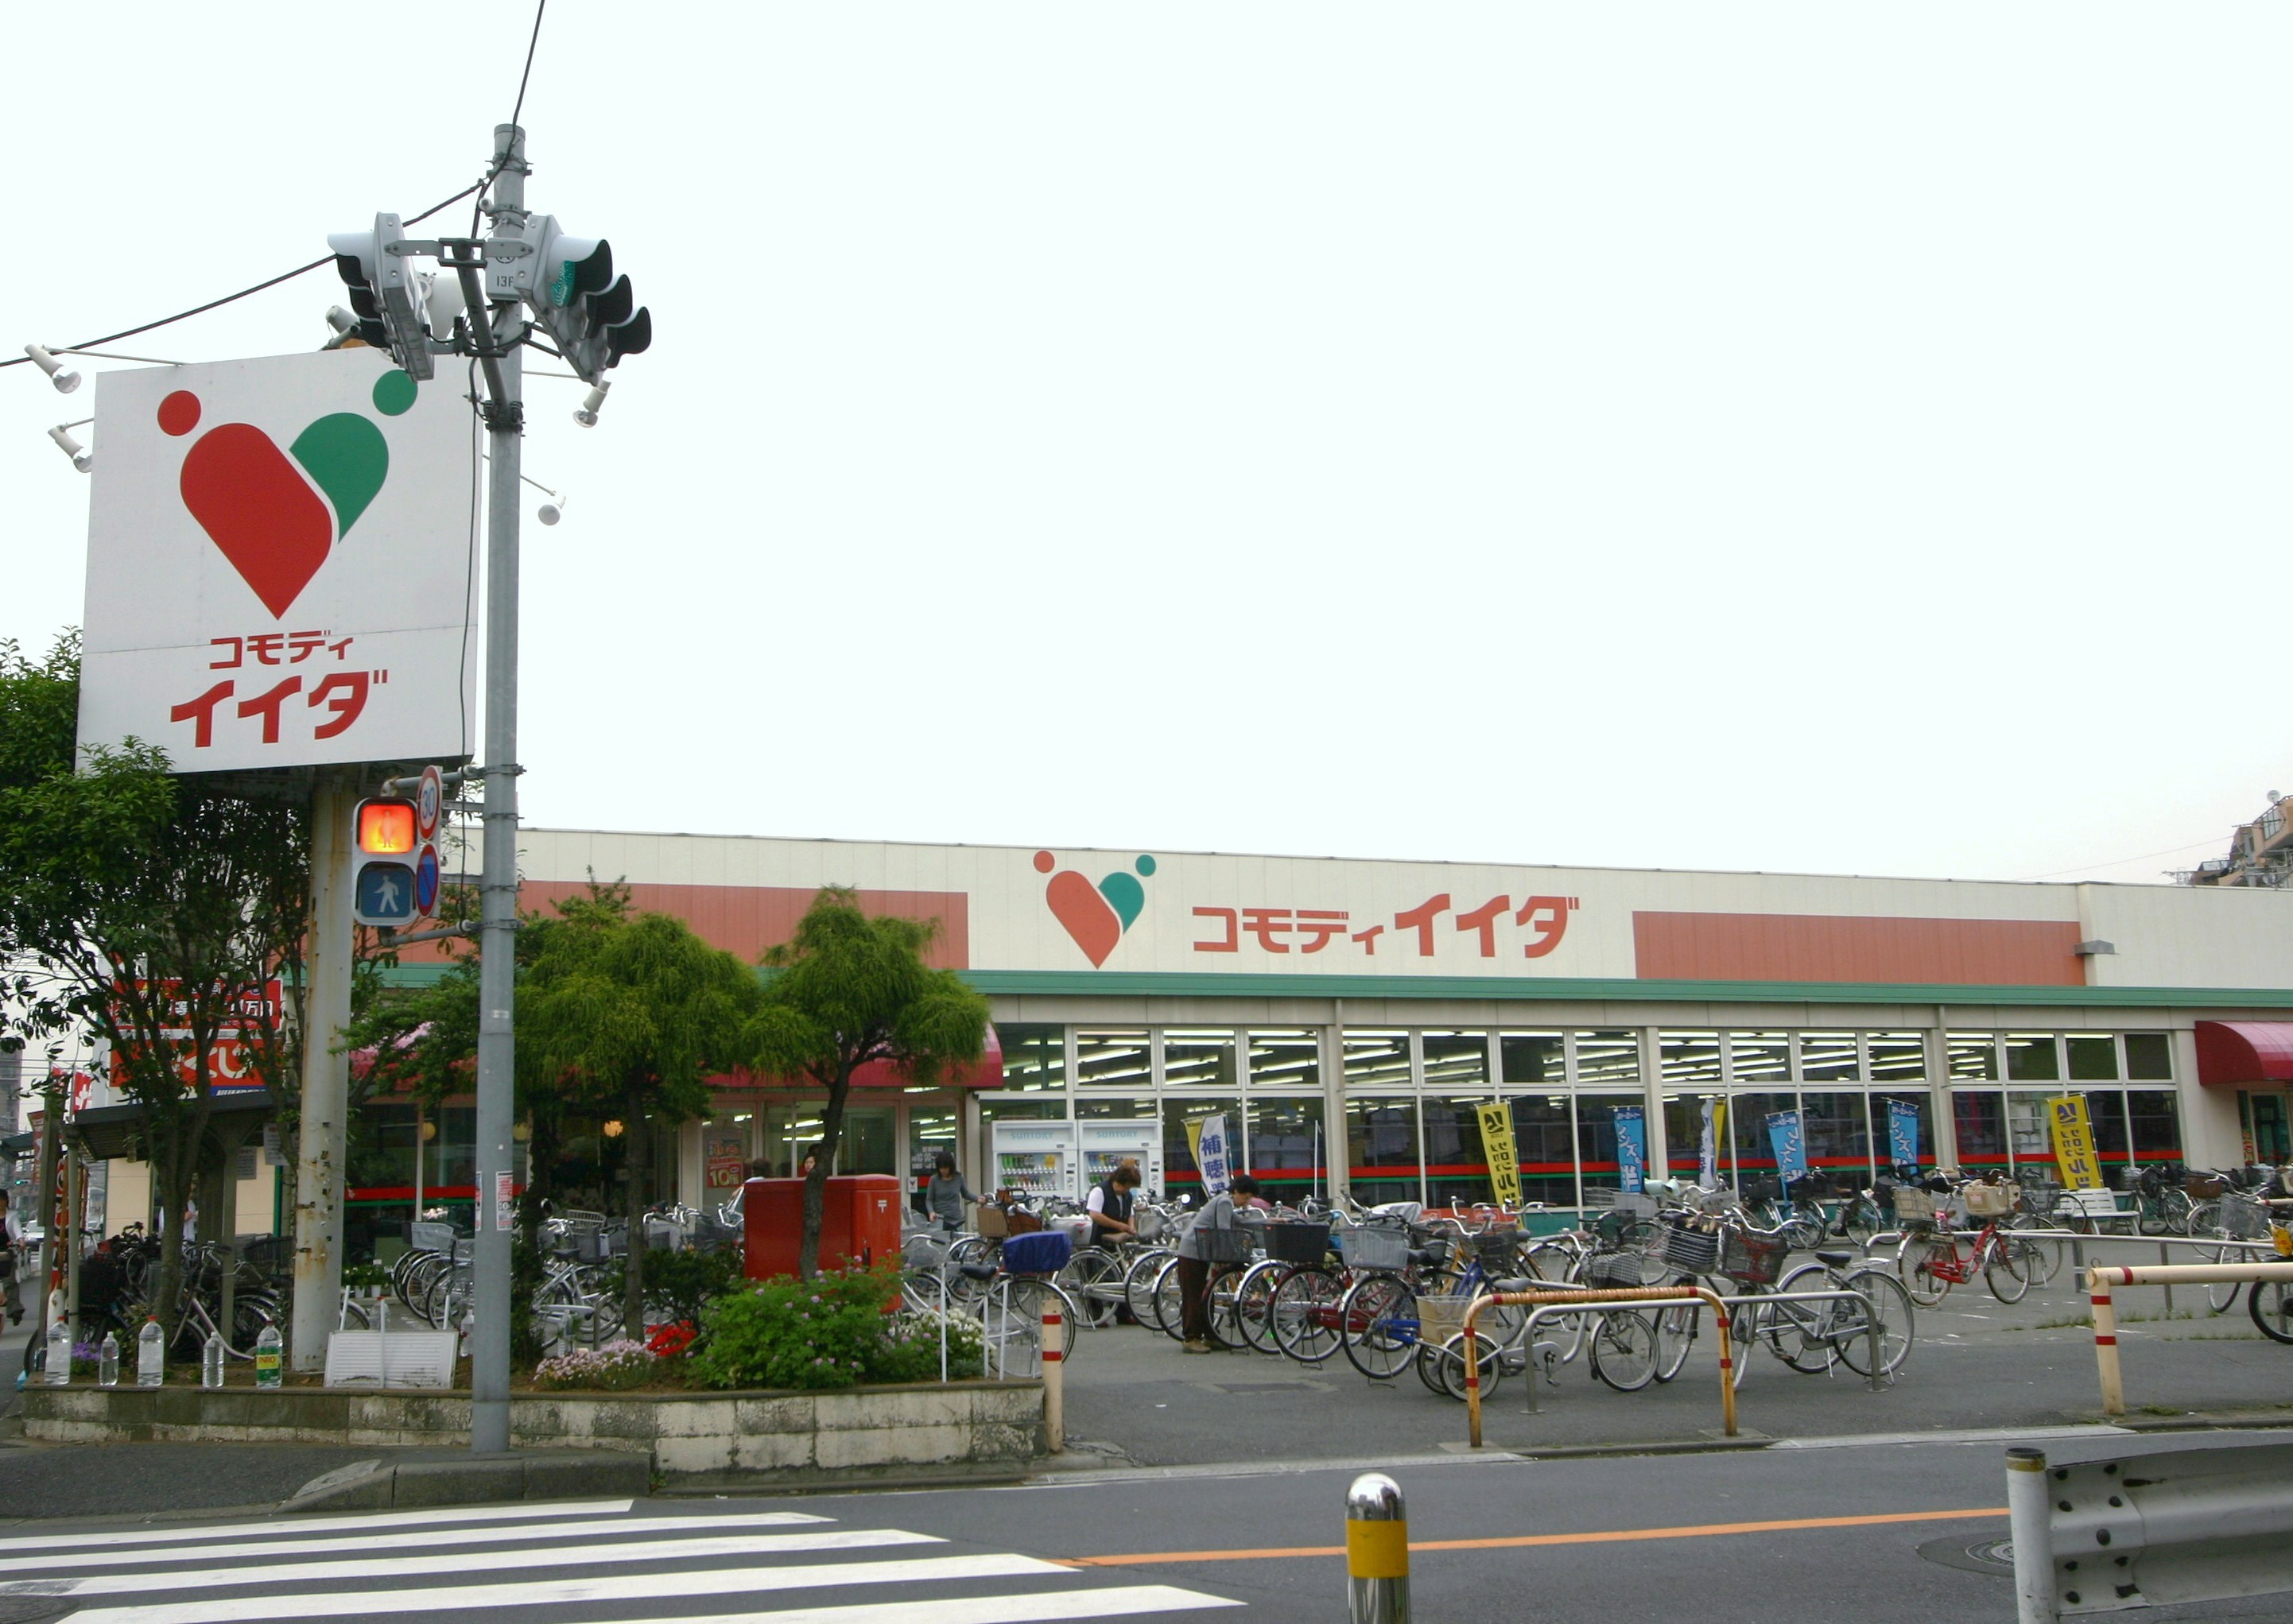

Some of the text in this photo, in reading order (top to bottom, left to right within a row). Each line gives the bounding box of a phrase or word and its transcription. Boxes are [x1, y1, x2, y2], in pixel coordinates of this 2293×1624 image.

[209, 630, 353, 670] コモディ
[170, 669, 388, 748] イイダ
[421, 786, 436, 820] 30
